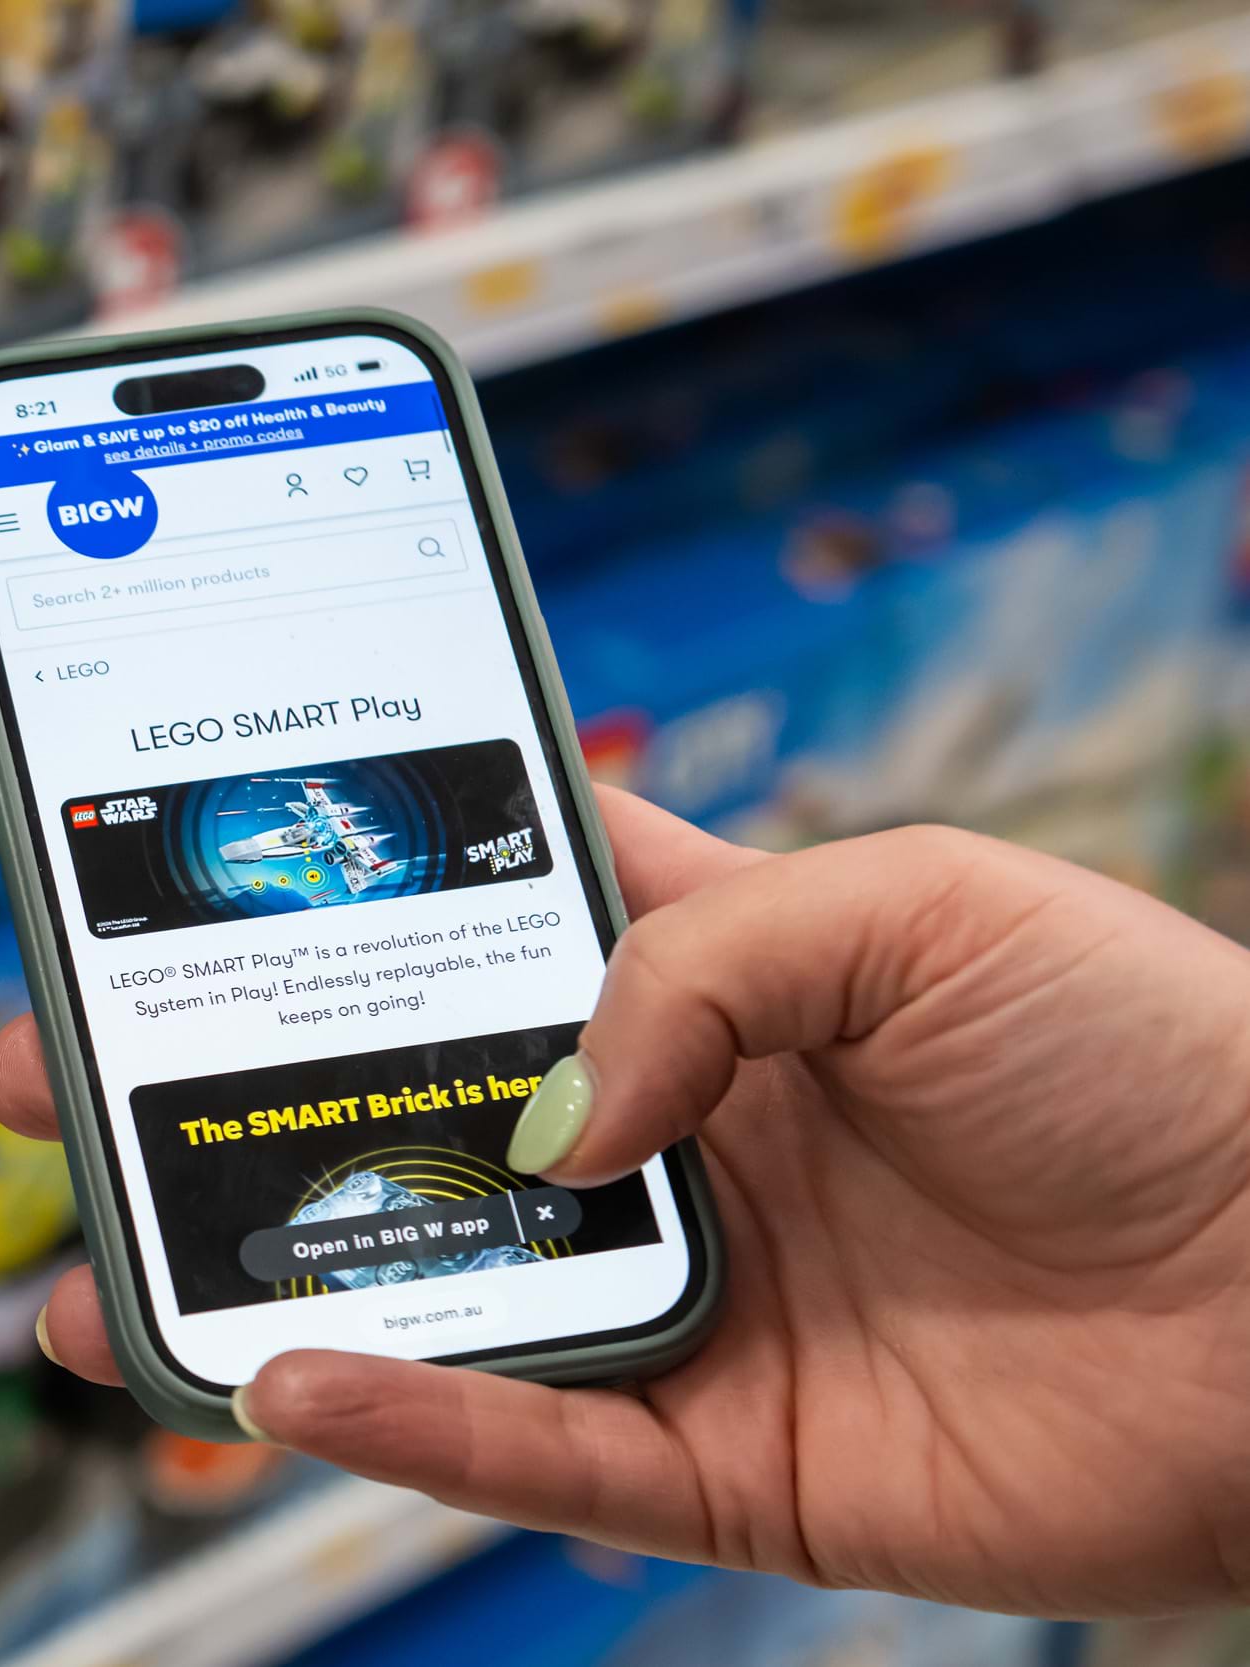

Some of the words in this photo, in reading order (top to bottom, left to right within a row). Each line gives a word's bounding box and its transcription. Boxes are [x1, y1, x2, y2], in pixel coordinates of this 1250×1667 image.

[324, 364, 348, 378] 5G
[15, 400, 57, 419] 8:21
[33, 439, 80, 454] Glam
[82, 434, 97, 448] &
[98, 428, 140, 446] SAVE
[142, 428, 166, 441] up
[167, 424, 187, 437] to
[188, 417, 222, 435] $20
[223, 413, 249, 429] off
[250, 408, 308, 426] Health
[310, 405, 325, 418] &
[325, 398, 387, 416] Beauty
[104, 449, 133, 464] see
[134, 439, 187, 460] details
[202, 434, 253, 451] promo
[257, 427, 304, 442] codes
[32, 587, 96, 609] Search
[100, 584, 121, 600] 2+
[127, 578, 186, 596] million
[190, 567, 271, 591] products
[56, 660, 110, 681] LEGO
[130, 717, 224, 753] LEGO
[233, 700, 340, 738] SMART
[350, 695, 422, 722] Play
[74, 810, 96, 823] LEGO
[100, 796, 157, 814] STAR
[100, 806, 158, 825] WARS
[466, 827, 533, 863] SMART
[494, 847, 534, 872] PLAY
[109, 966, 177, 990] LEGO®
[182, 955, 246, 979] SMART
[314, 945, 331, 960] is
[335, 946, 348, 957] a
[353, 931, 444, 955] revolution
[449, 924, 467, 941] of
[472, 922, 503, 938] the
[506, 911, 561, 933] LEGO
[134, 996, 204, 1019] System
[208, 991, 227, 1006] in
[230, 981, 280, 1005] Play!
[282, 970, 371, 995] Endlessly
[376, 954, 482, 983] replayable,
[485, 949, 516, 965] the
[520, 945, 552, 960] fun
[277, 1006, 334, 1028] keeps
[338, 1004, 361, 1017] on
[366, 990, 426, 1017] going!
[179, 1117, 244, 1146] The
[247, 1096, 361, 1137] SMART
[366, 1083, 454, 1119] Brick
[453, 1078, 485, 1106] is
[486, 1074, 541, 1101] her
[292, 1239, 349, 1260] Open
[352, 1234, 375, 1250] in
[379, 1225, 420, 1246] BIG
[423, 1221, 443, 1238] W
[450, 1218, 490, 1237] app
[383, 1304, 483, 1330] bigw.com.au
